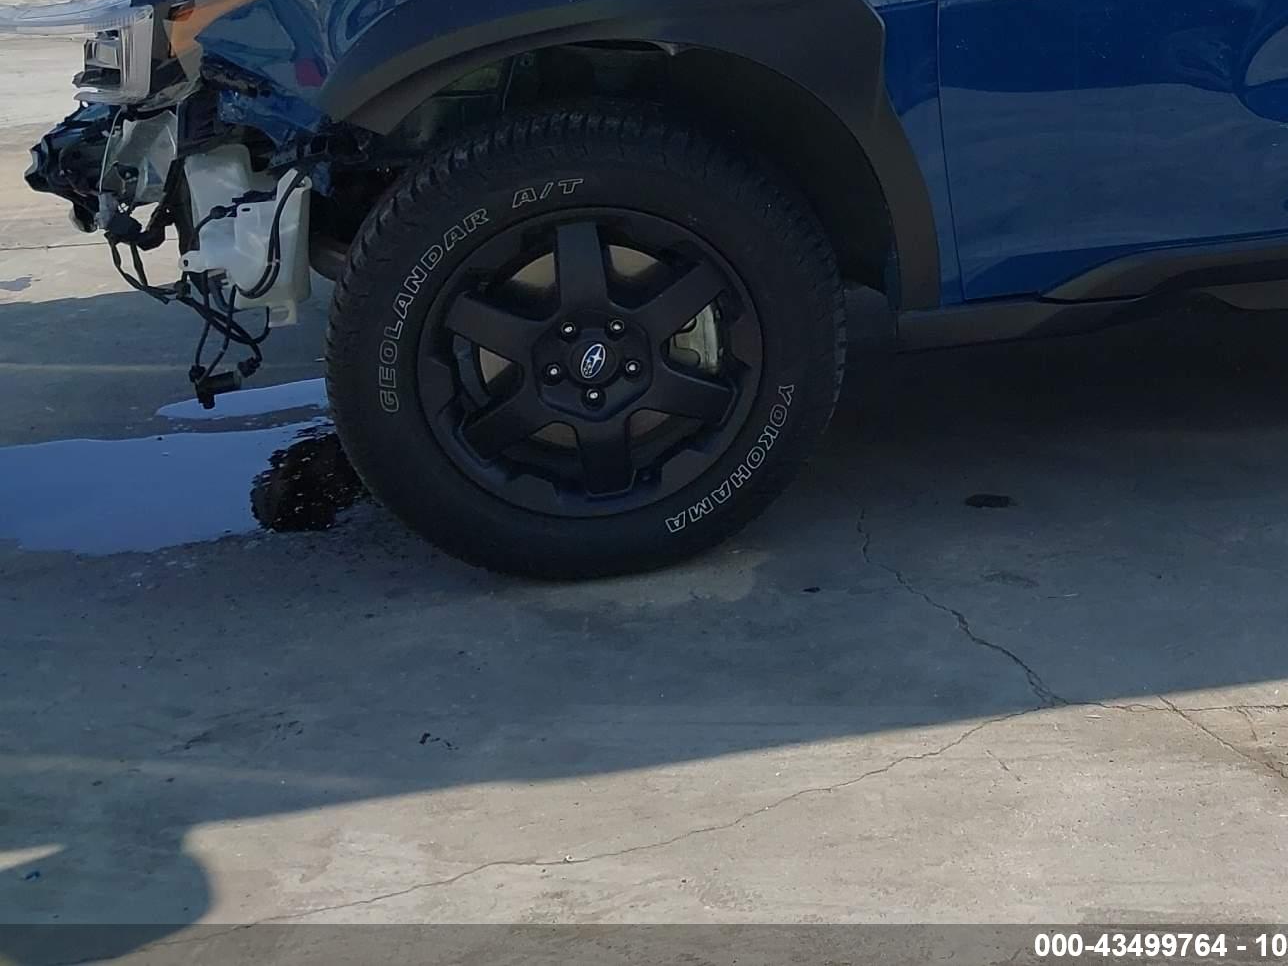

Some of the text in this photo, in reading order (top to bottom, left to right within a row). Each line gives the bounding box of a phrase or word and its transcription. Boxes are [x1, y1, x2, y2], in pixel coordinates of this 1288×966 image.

[379, 178, 584, 413] GEOLANDAR A/T
[665, 384, 795, 533] YOKOHAMA
